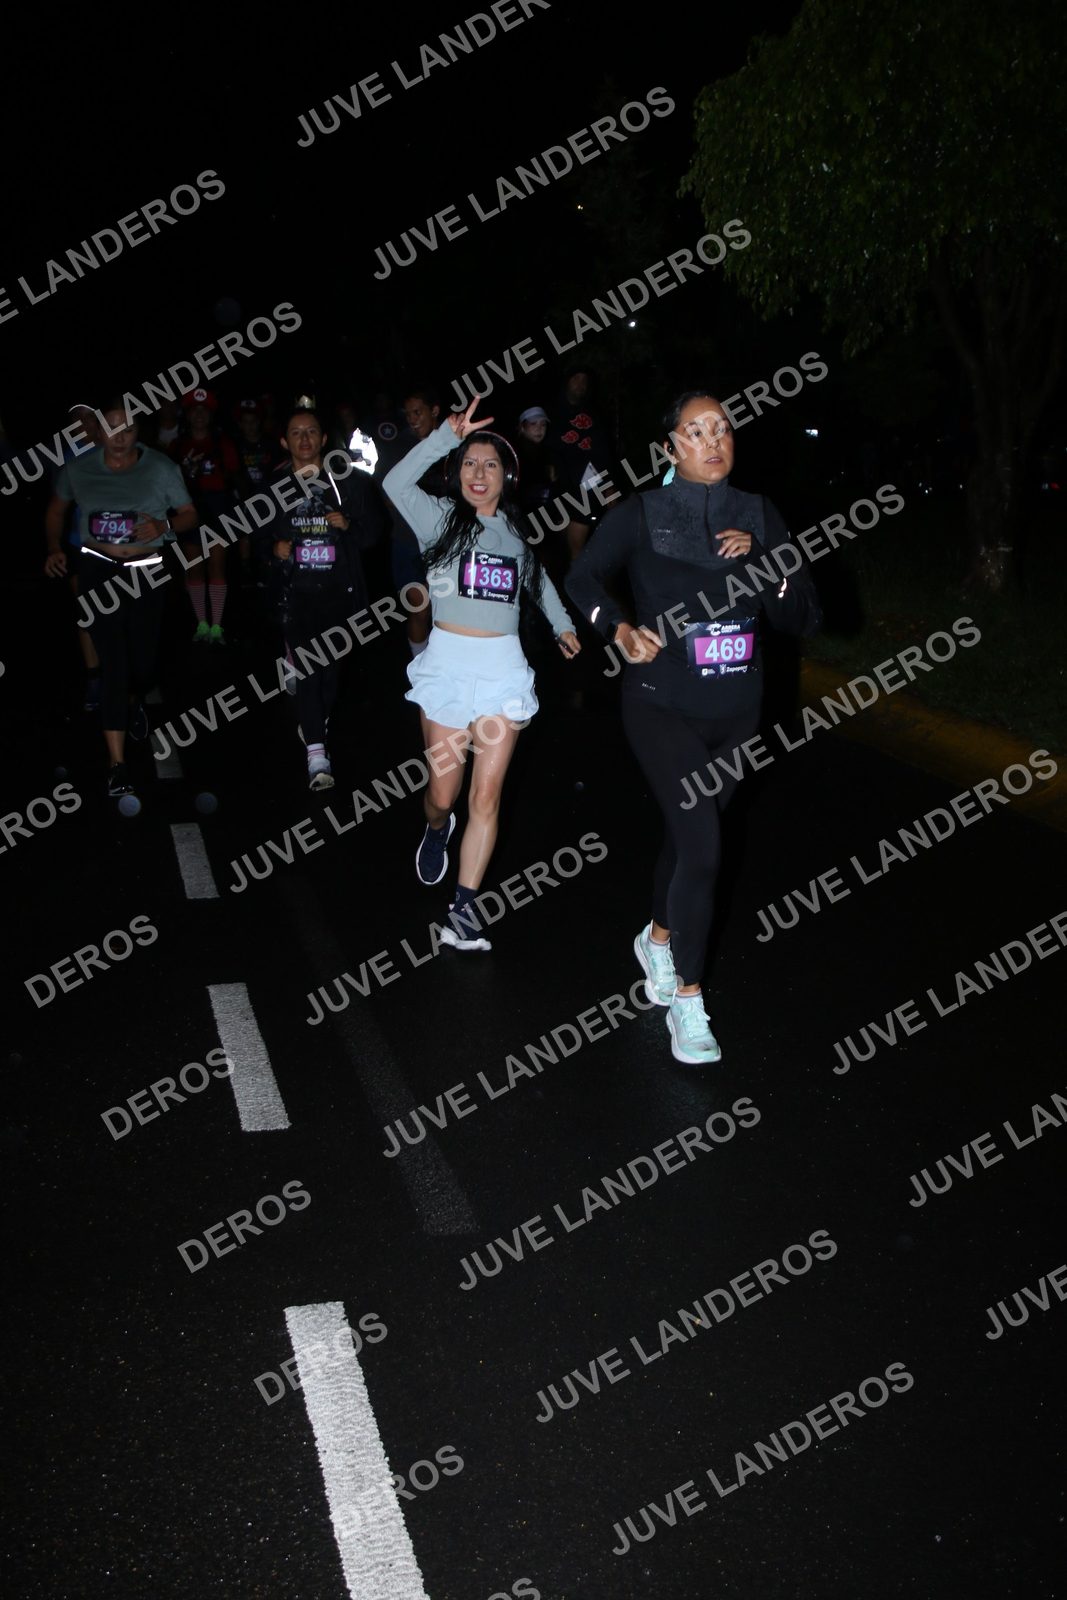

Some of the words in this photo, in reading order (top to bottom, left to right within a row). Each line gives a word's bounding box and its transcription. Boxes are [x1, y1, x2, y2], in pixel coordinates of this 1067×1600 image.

[99, 521, 127, 534] 794
[291, 517, 312, 526] CALL
[301, 547, 330, 561] 944
[468, 566, 513, 589] 1363
[705, 637, 746, 662] 469
